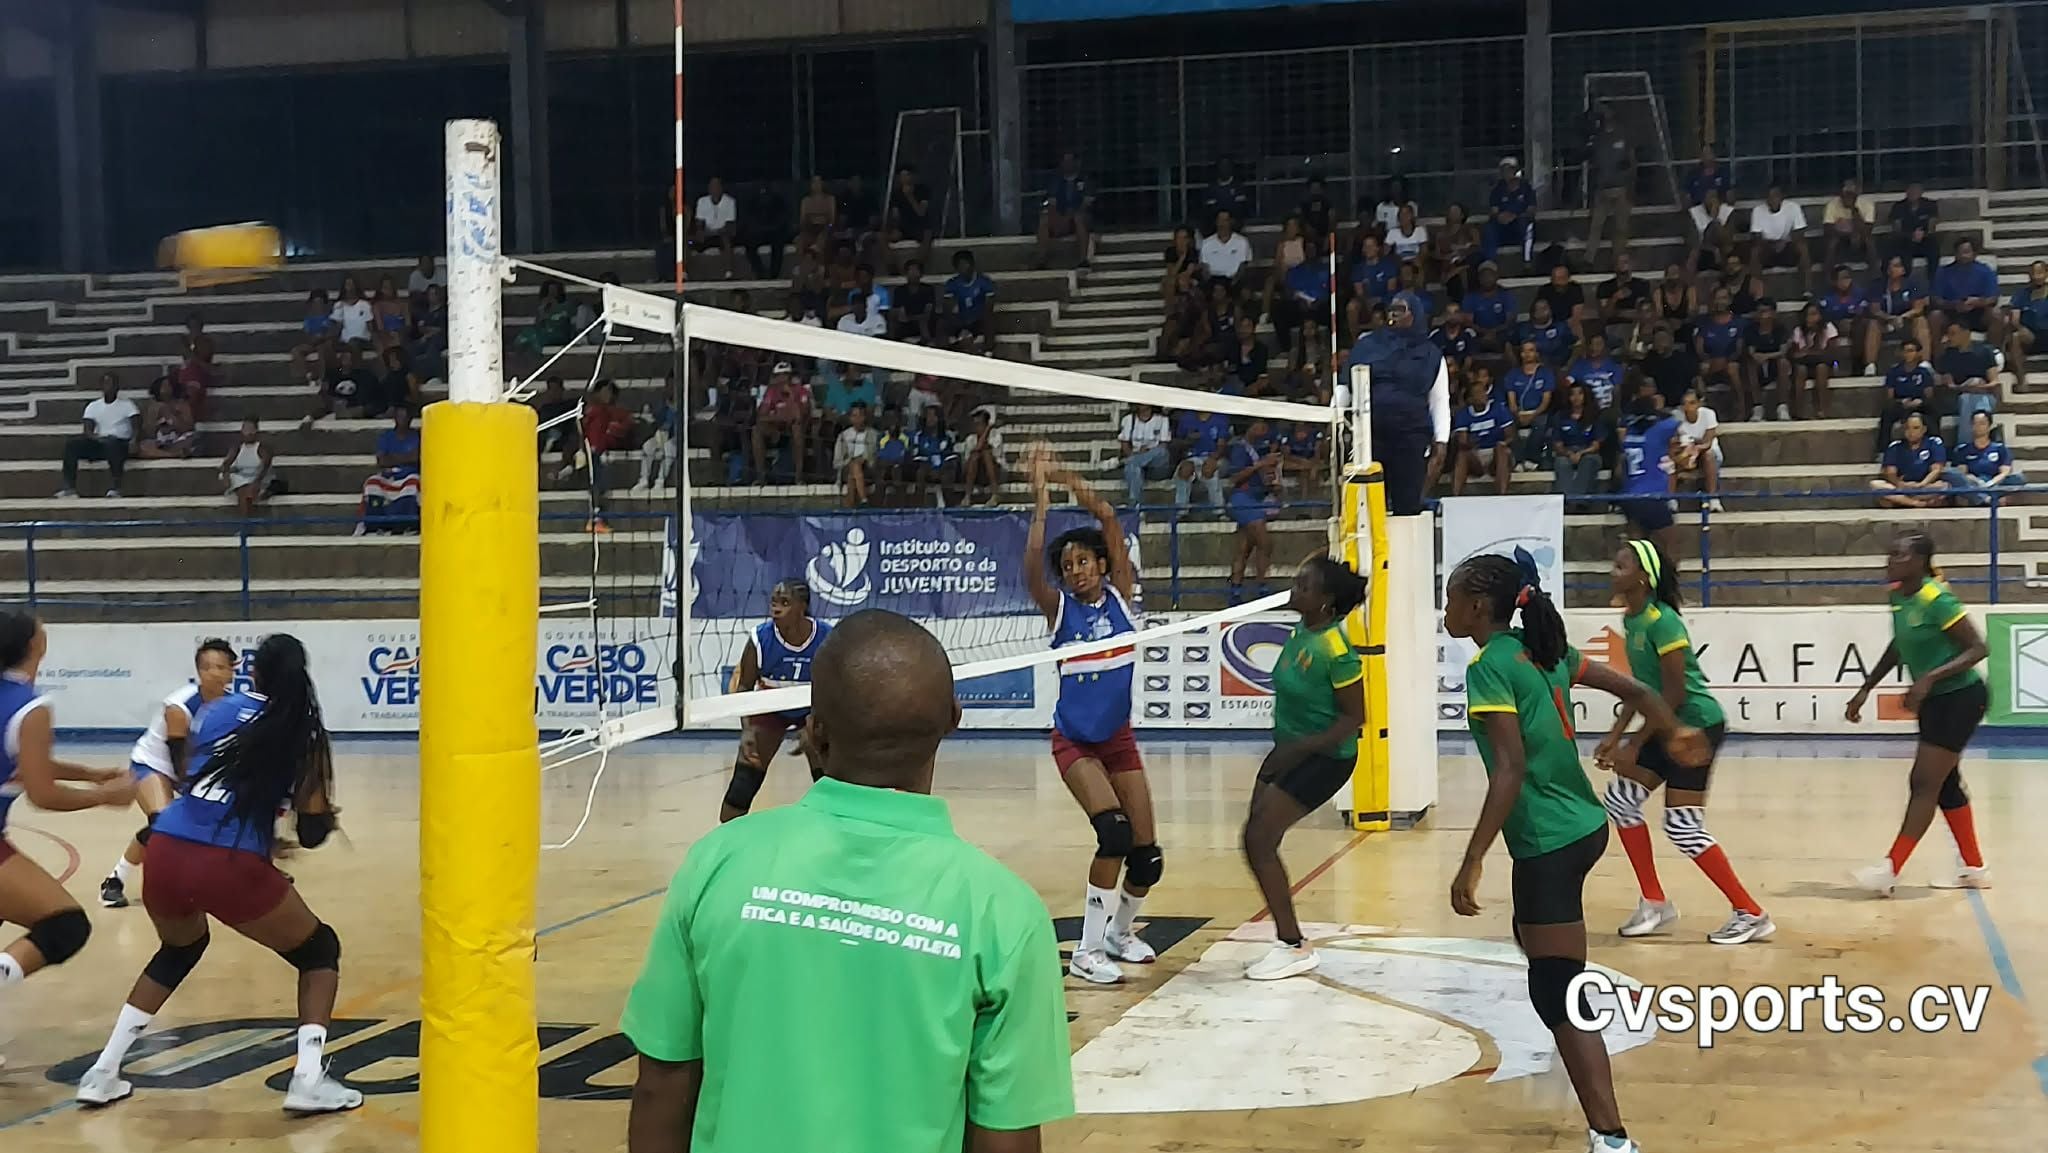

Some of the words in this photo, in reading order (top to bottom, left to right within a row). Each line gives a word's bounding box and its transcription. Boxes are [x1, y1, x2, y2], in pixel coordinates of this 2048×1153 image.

[880, 539, 951, 555] Instituto
[954, 538, 976, 554] do
[880, 558, 962, 573] DESPORTO
[965, 561, 975, 572] e
[978, 557, 997, 572] da
[880, 576, 996, 594] JUVENTUDE
[369, 646, 420, 674] CA
[546, 645, 646, 674] CABO
[793, 662, 802, 680] 7
[1695, 643, 1909, 683] AFA
[539, 675, 657, 704] VERDE
[752, 886, 778, 901] UM
[780, 889, 903, 924] COMPROMISSO
[905, 913, 944, 934] COM
[945, 923, 959, 938] A
[741, 902, 786, 924] ÉTICA
[789, 912, 800, 926] E
[801, 914, 815, 929] A
[819, 916, 874, 939] SAÚDE
[875, 926, 900, 944] DO
[901, 934, 961, 959] ATLETA
